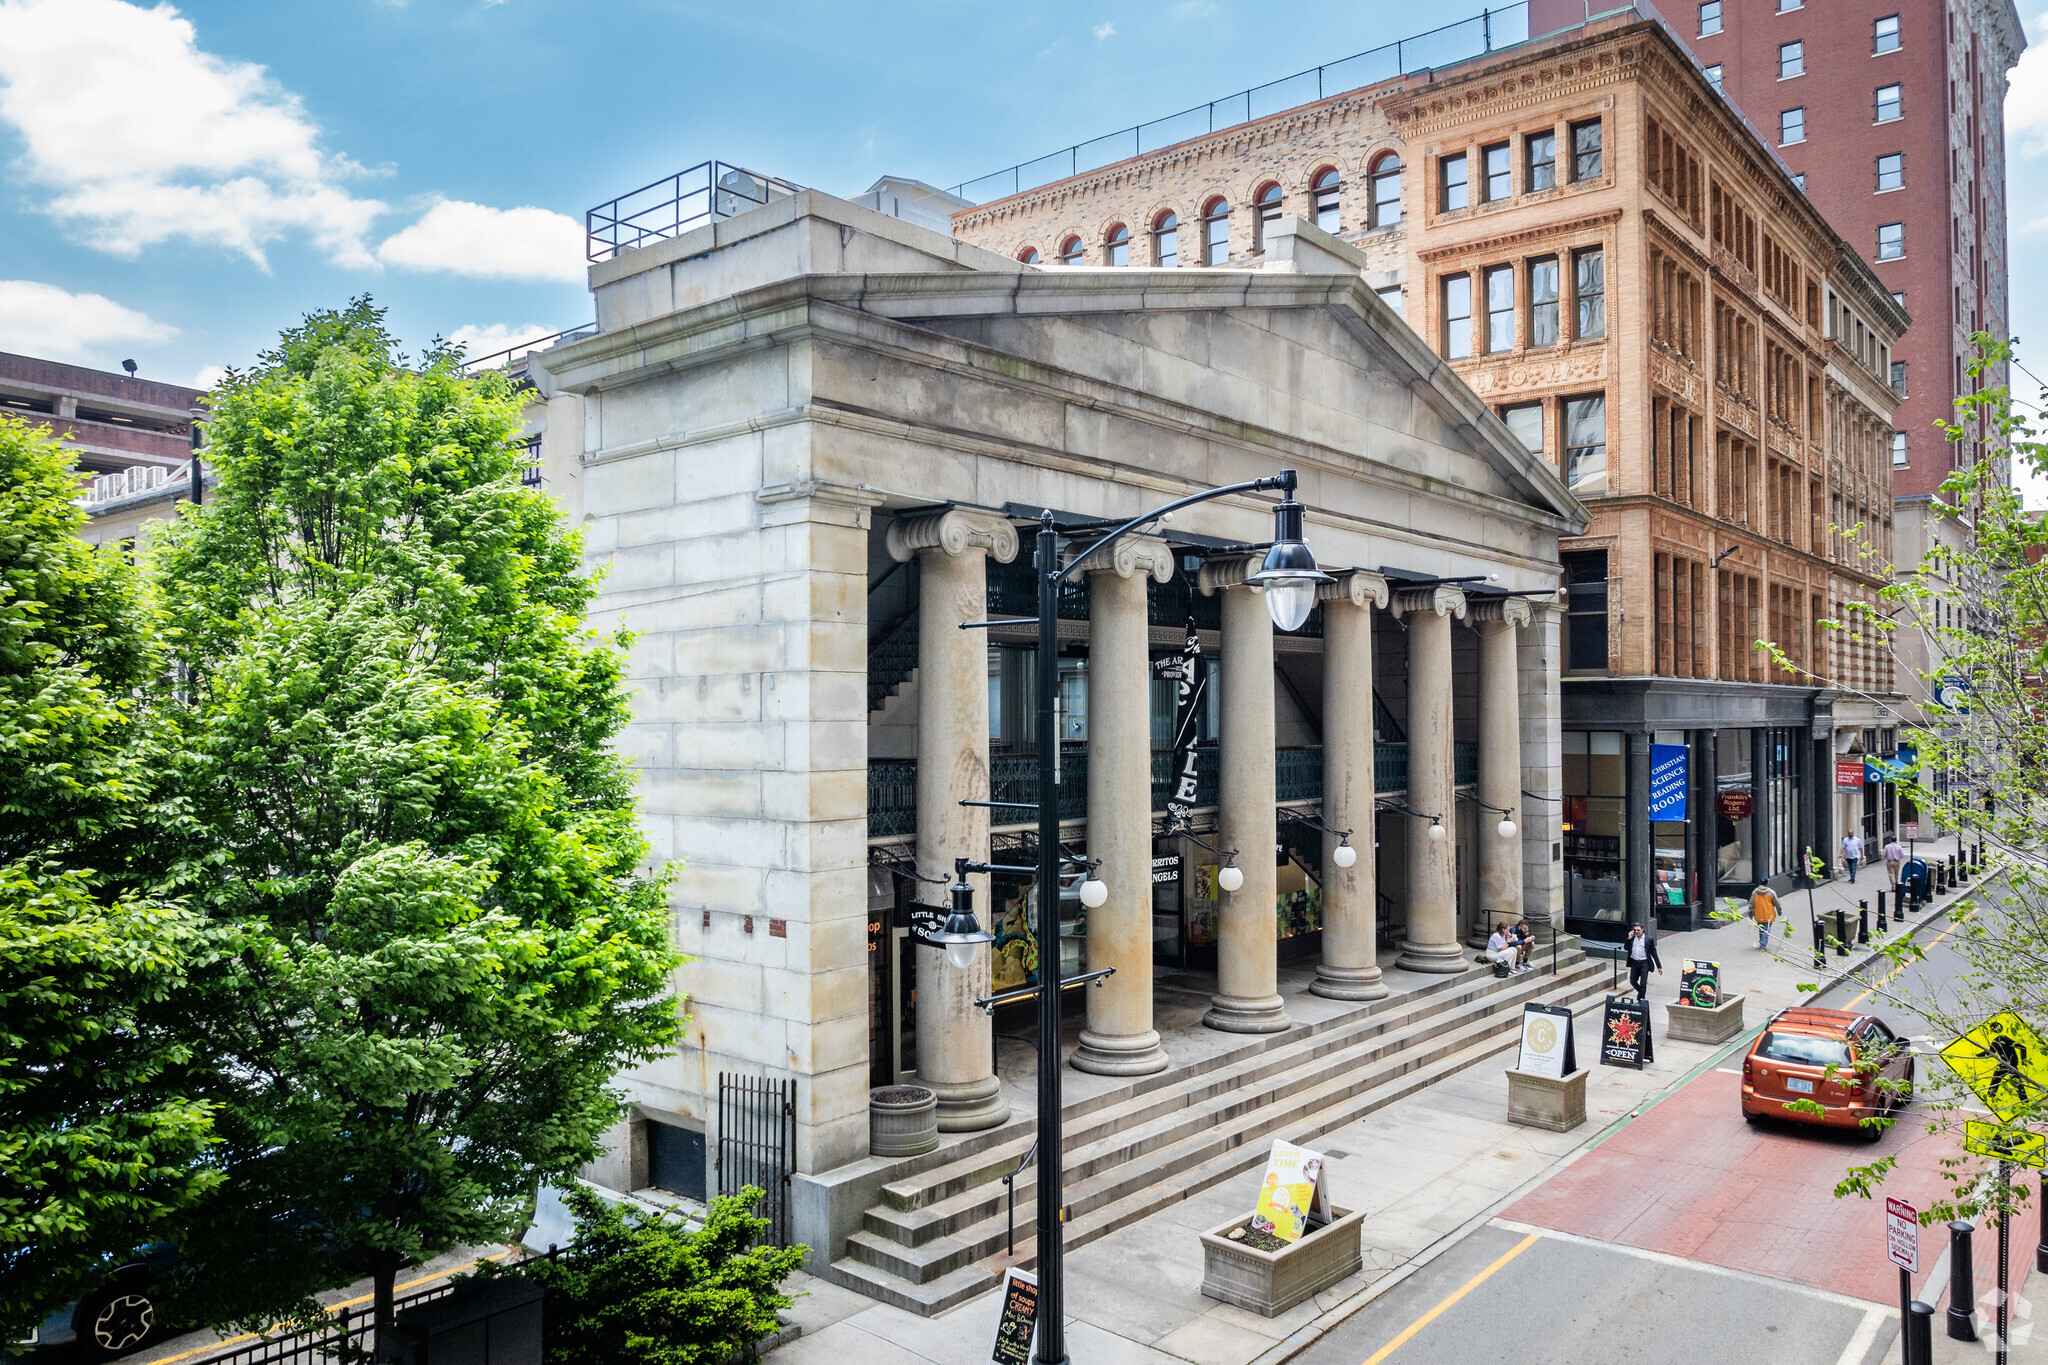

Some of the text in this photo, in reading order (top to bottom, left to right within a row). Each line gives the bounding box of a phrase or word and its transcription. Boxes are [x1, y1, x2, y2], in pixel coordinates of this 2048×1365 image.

[1155, 657, 1171, 670] THE
[1651, 754, 1685, 775] CHRISTIAN
[1651, 766, 1685, 787] SCIENCE
[1651, 779, 1685, 799] READING
[1651, 791, 1685, 813] ROOM
[1723, 799, 1746, 807] Rogers
[1152, 856, 1179, 868] RRITOS
[1152, 870, 1179, 883] NGELS
[911, 911, 934, 919] LITTLE
[1537, 1028, 1546, 1043] C
[1610, 1049, 1637, 1060] OPEN
[1273, 1149, 1301, 1158] LUNCH
[1273, 1158, 1298, 1168] TIME
[1888, 1200, 1916, 1222] WARNING
[1897, 1218, 1907, 1230] NO
[1889, 1224, 1916, 1244] PARKING
[1891, 1243, 1914, 1258] SIDEWALK
[1897, 1239, 1916, 1252] HOLLOW
[1012, 1278, 1026, 1290] little
[1010, 1292, 1035, 1308] of soups
[1009, 1300, 1035, 1317] CREAMY
